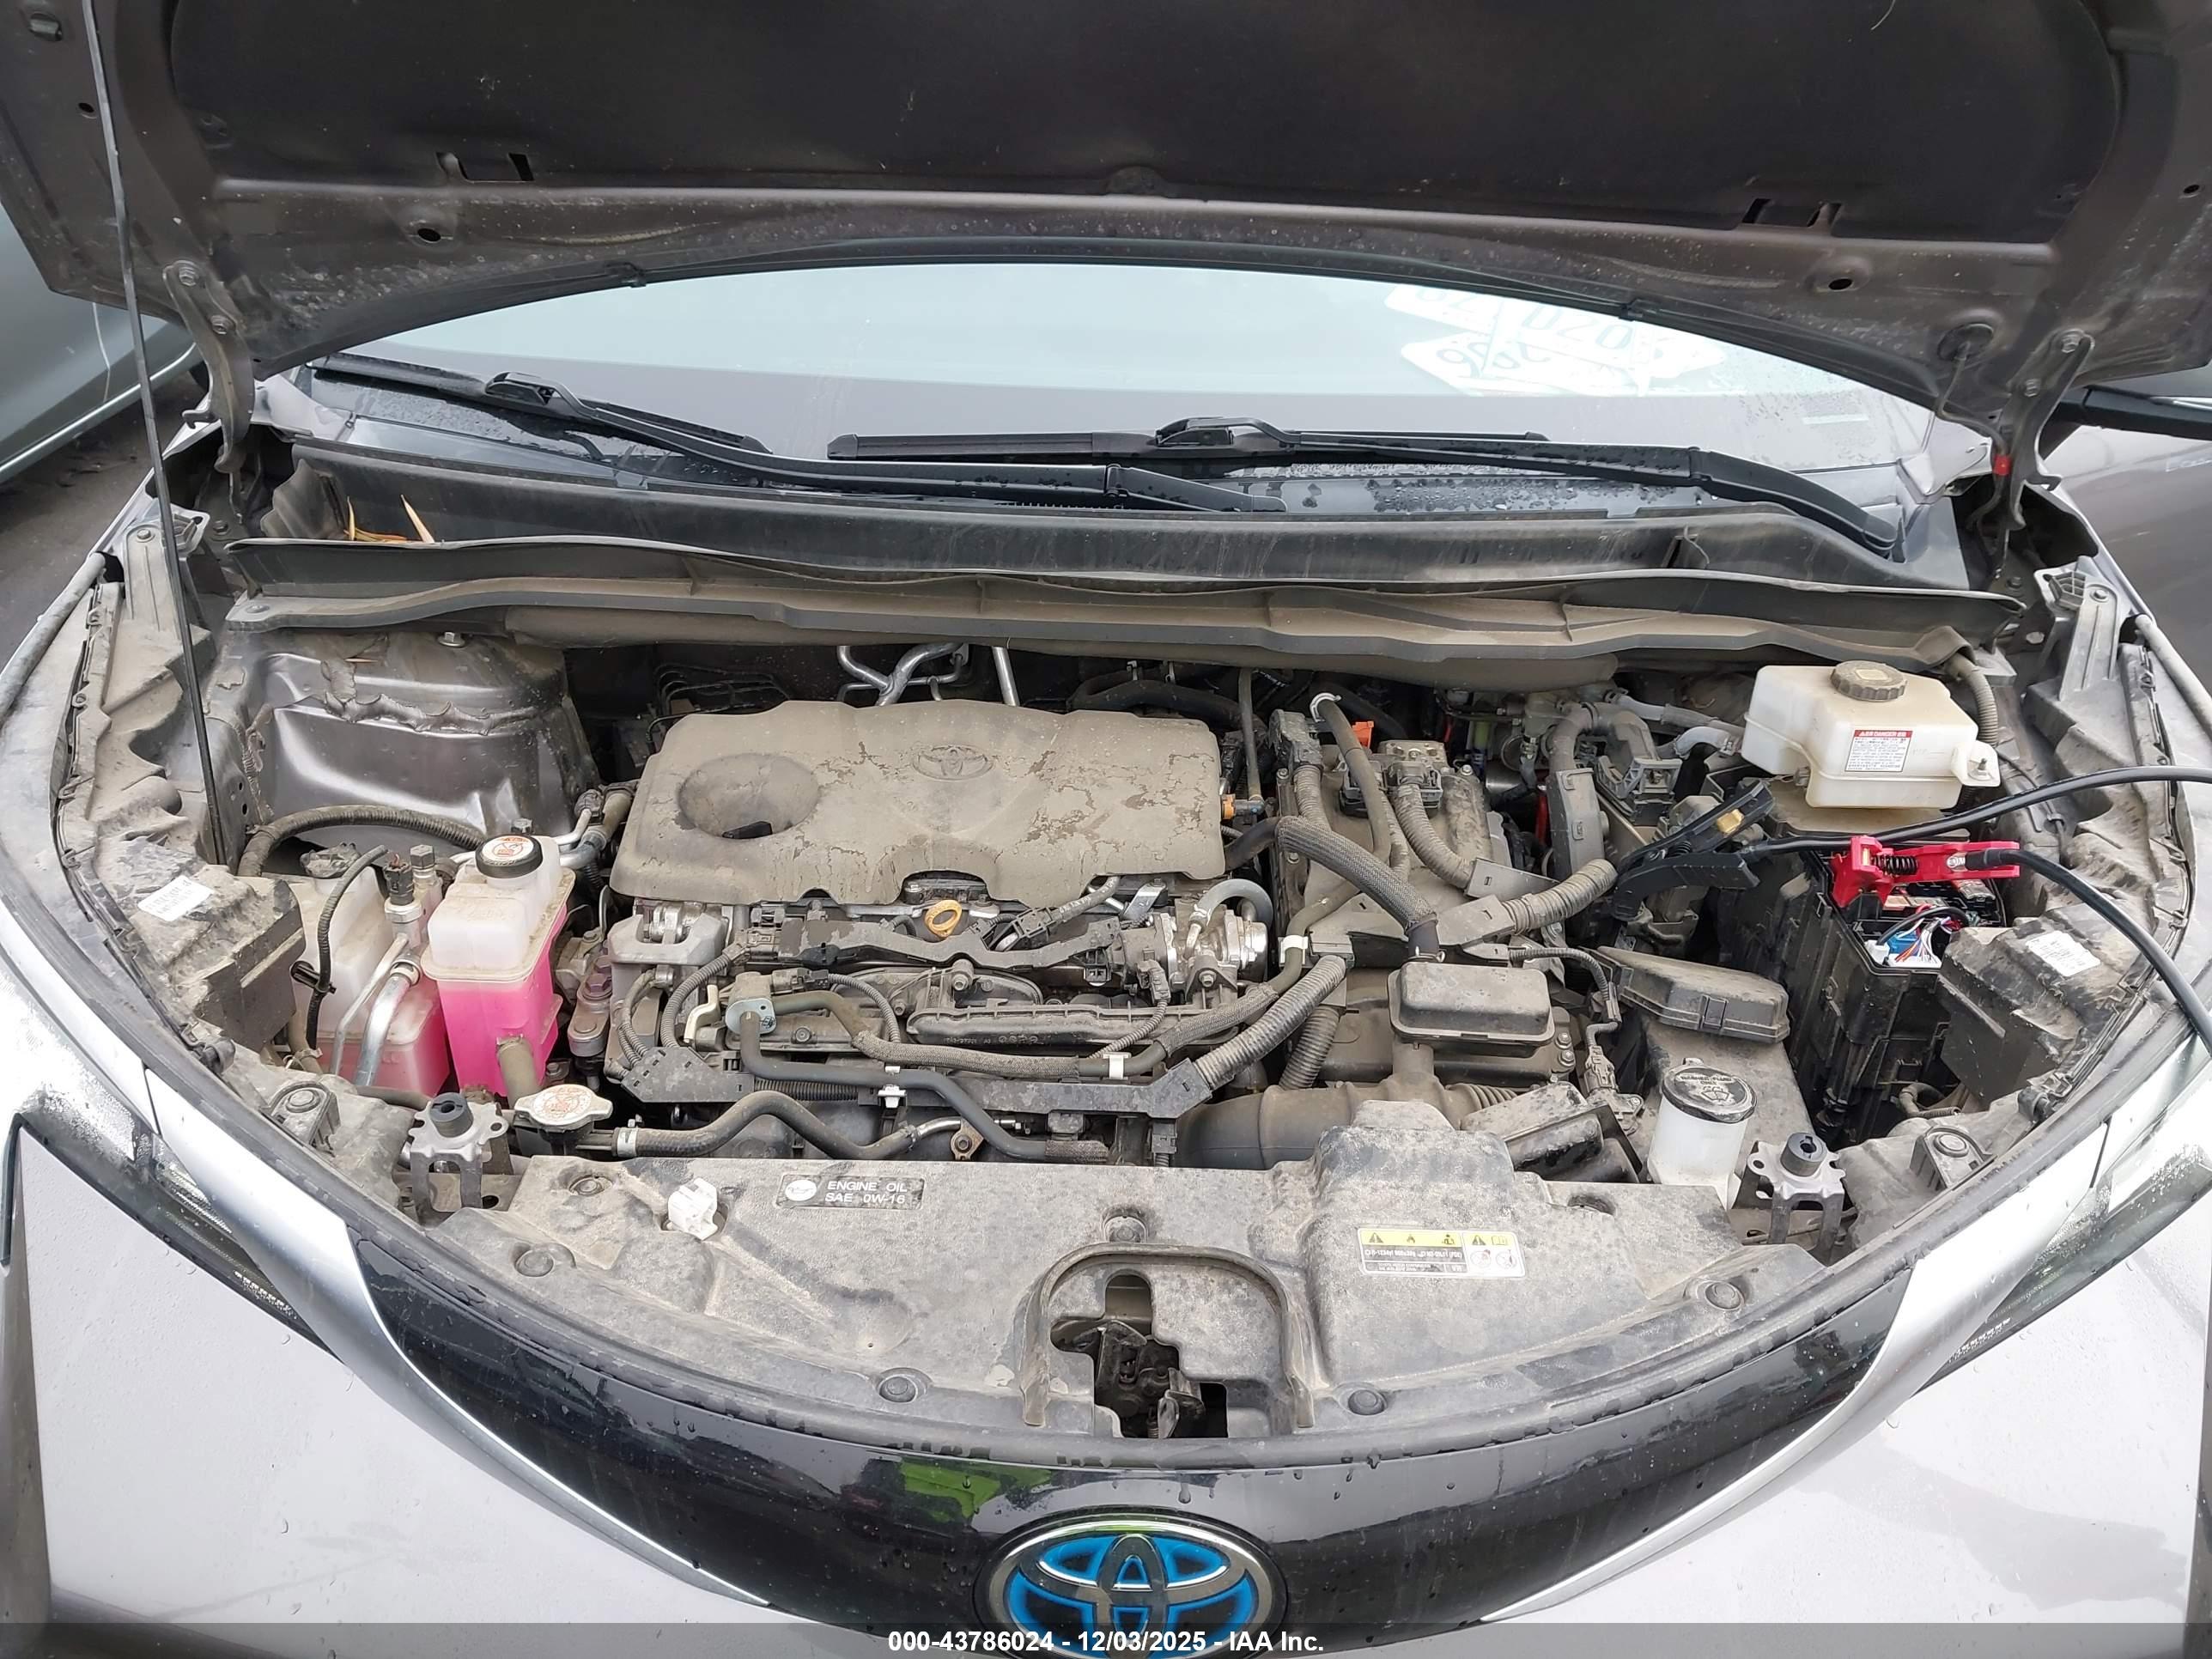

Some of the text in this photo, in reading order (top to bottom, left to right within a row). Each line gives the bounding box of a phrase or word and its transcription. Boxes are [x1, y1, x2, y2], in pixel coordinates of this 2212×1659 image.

[827, 1181, 908, 1193] ENGINE OIL
[824, 1192, 905, 1204] SAE 0W-16
